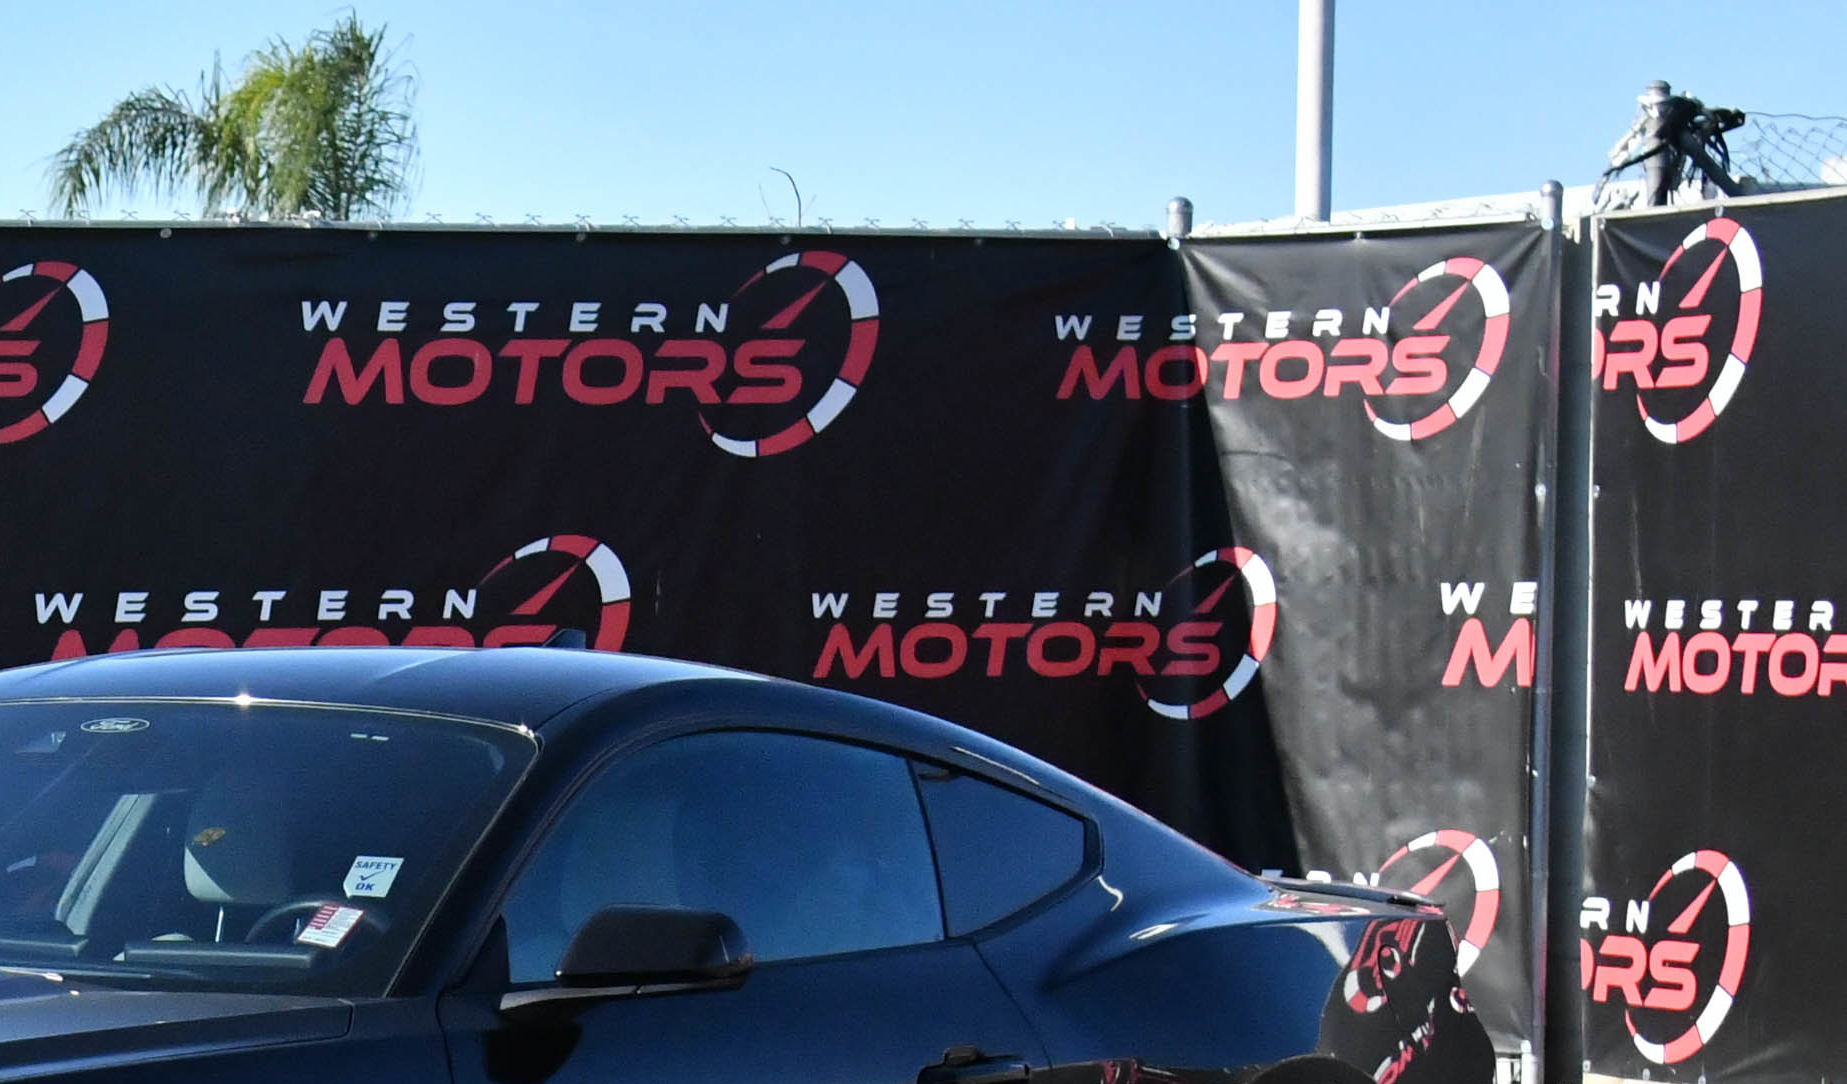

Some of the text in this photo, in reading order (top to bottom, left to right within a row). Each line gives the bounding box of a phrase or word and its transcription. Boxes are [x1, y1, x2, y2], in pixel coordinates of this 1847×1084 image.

[301, 300, 729, 333] WESTERN
[1055, 306, 1393, 341] WESTERN
[1057, 333, 1452, 401] MOTORS
[1593, 314, 1713, 391] RS
[304, 337, 805, 405] MOTORS
[35, 589, 477, 624] WESTERN
[811, 591, 1162, 618] WESTERN
[1624, 599, 1835, 631] WESTER
[813, 621, 1223, 679] MOTORS
[355, 861, 397, 870] SAFETY
[355, 883, 375, 891] OK
